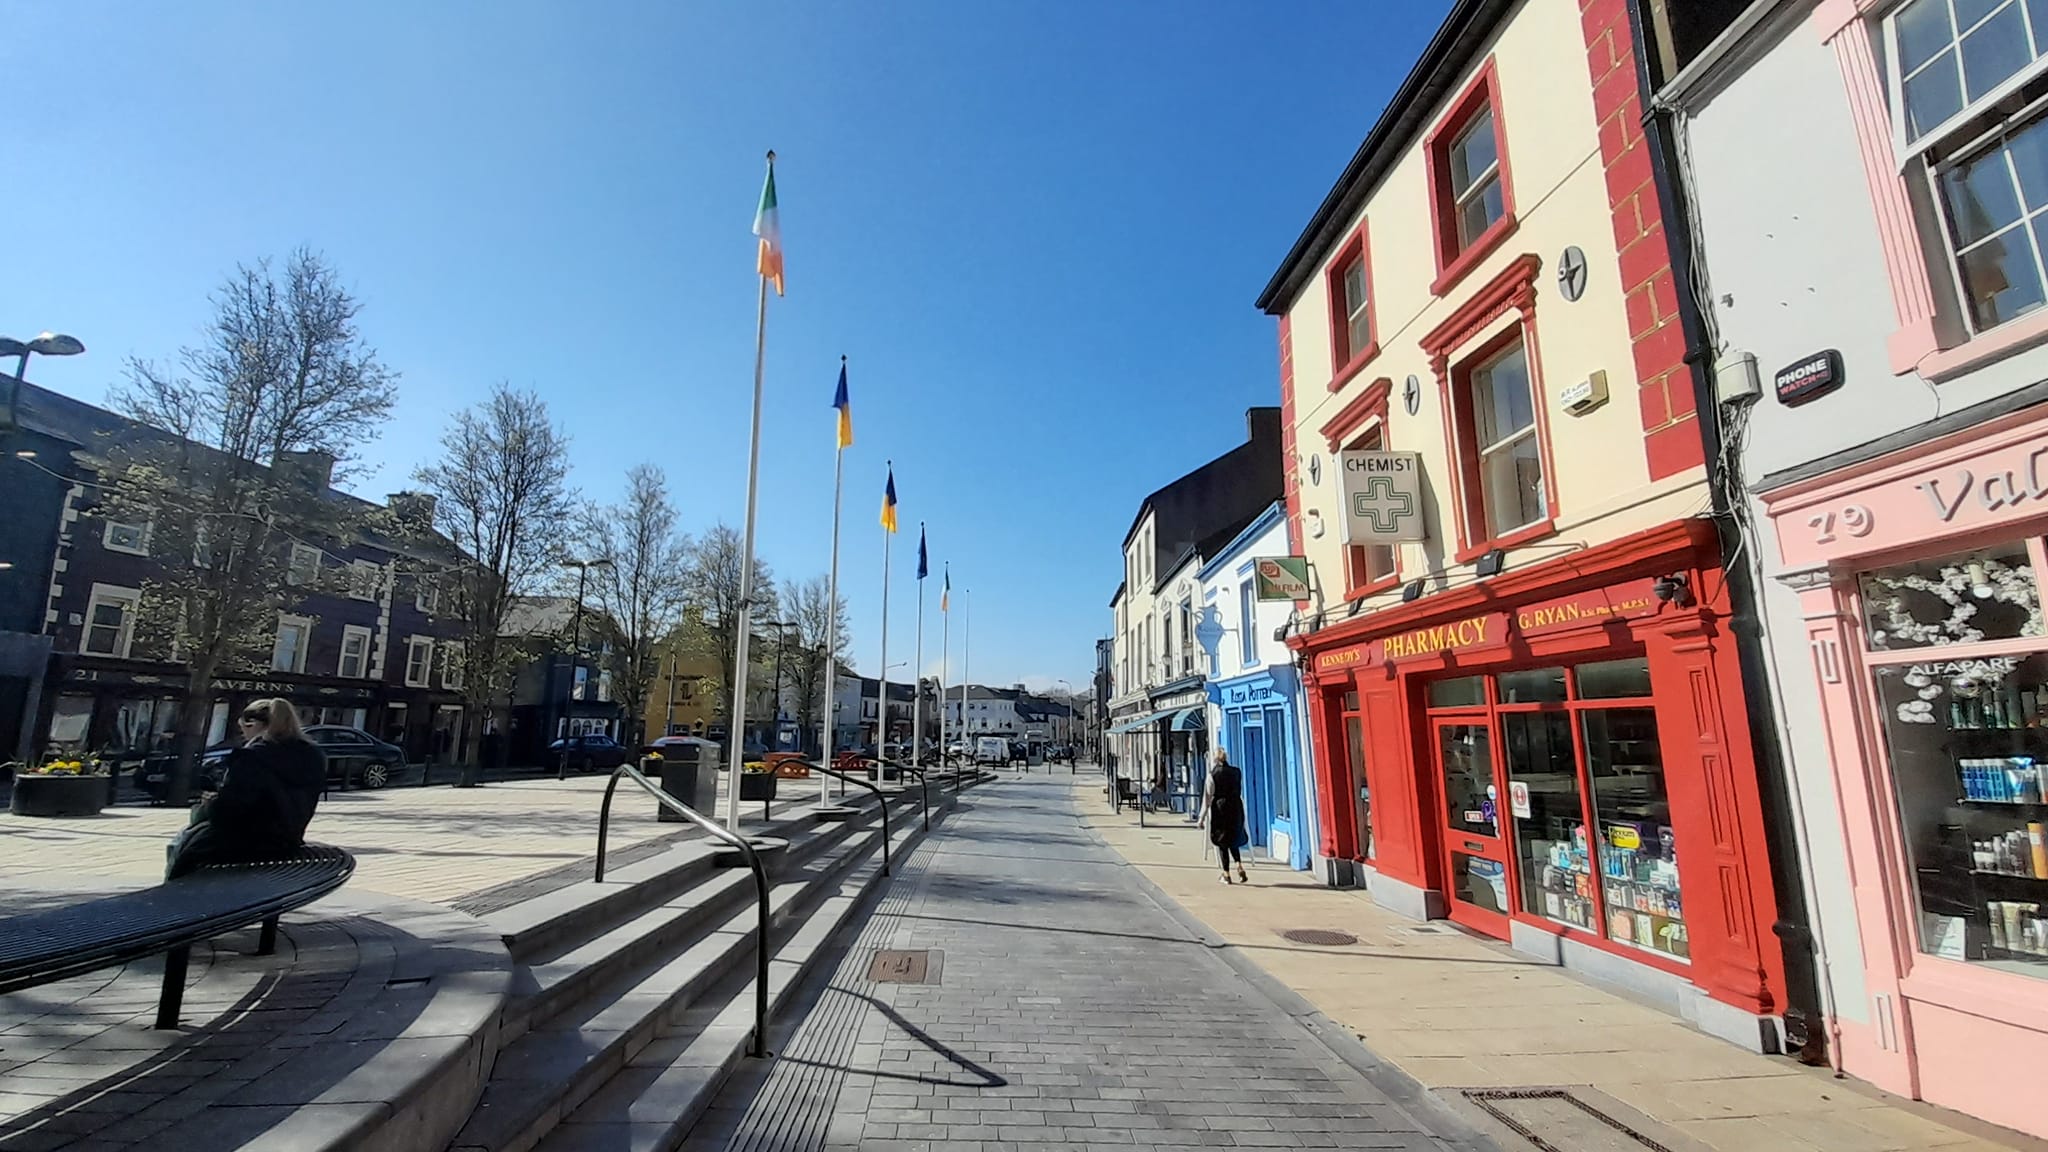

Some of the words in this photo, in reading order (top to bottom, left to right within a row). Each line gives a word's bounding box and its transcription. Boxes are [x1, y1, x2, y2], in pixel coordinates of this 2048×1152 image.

[1777, 359, 1827, 388] PHONE
[1780, 374, 1817, 395] WATCH
[1346, 458, 1412, 472] CHEMIST
[1808, 504, 1874, 544] 79
[1518, 613, 1533, 630] G.
[1534, 602, 1579, 627] RYAN
[1383, 616, 1487, 660] PHARMACY
[1908, 657, 2018, 675] ALFAPARF
[74, 669, 98, 681] 21
[210, 679, 296, 693] AVERNS
[357, 688, 371, 698] 21
